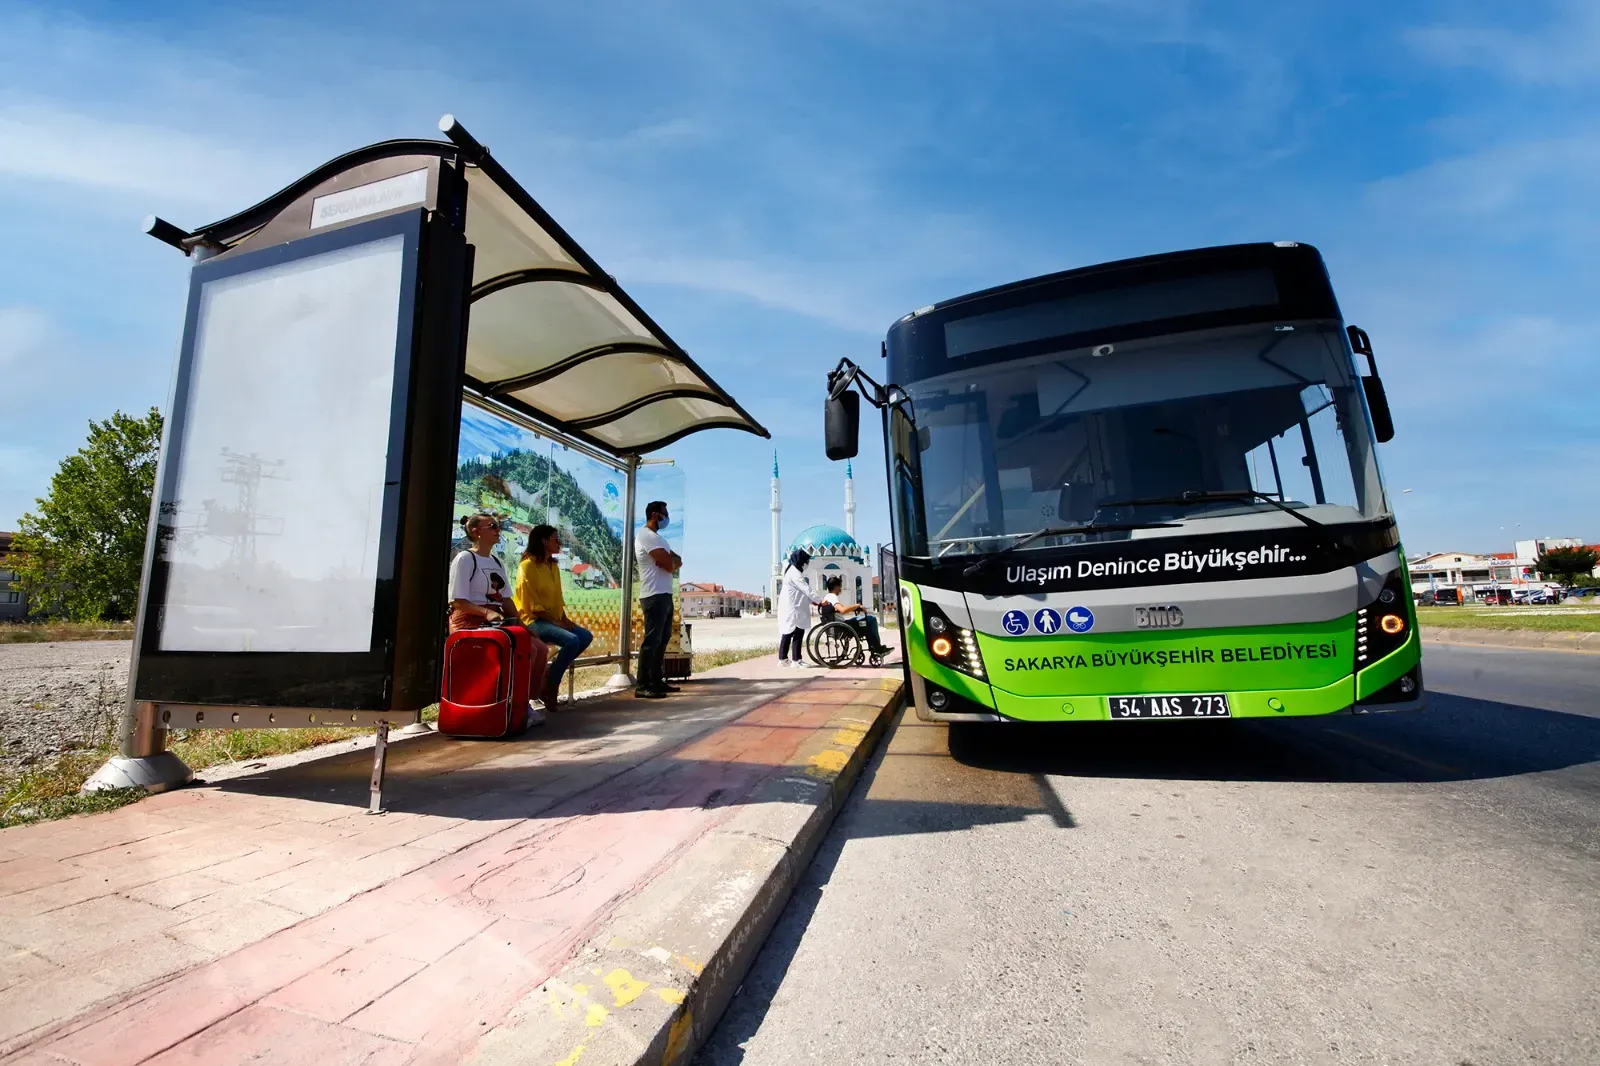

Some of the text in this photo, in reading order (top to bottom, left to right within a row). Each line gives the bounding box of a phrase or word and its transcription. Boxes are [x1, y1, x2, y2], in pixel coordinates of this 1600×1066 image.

[1006, 544, 1307, 585] Ulaşım Denince Büyükşehir...
[1135, 605, 1183, 628] BMC
[1004, 640, 1337, 672] SAKARYA BÜYÜKŞEHİR BELEDİYESİ
[1119, 696, 1226, 717] 54 AAS 273
